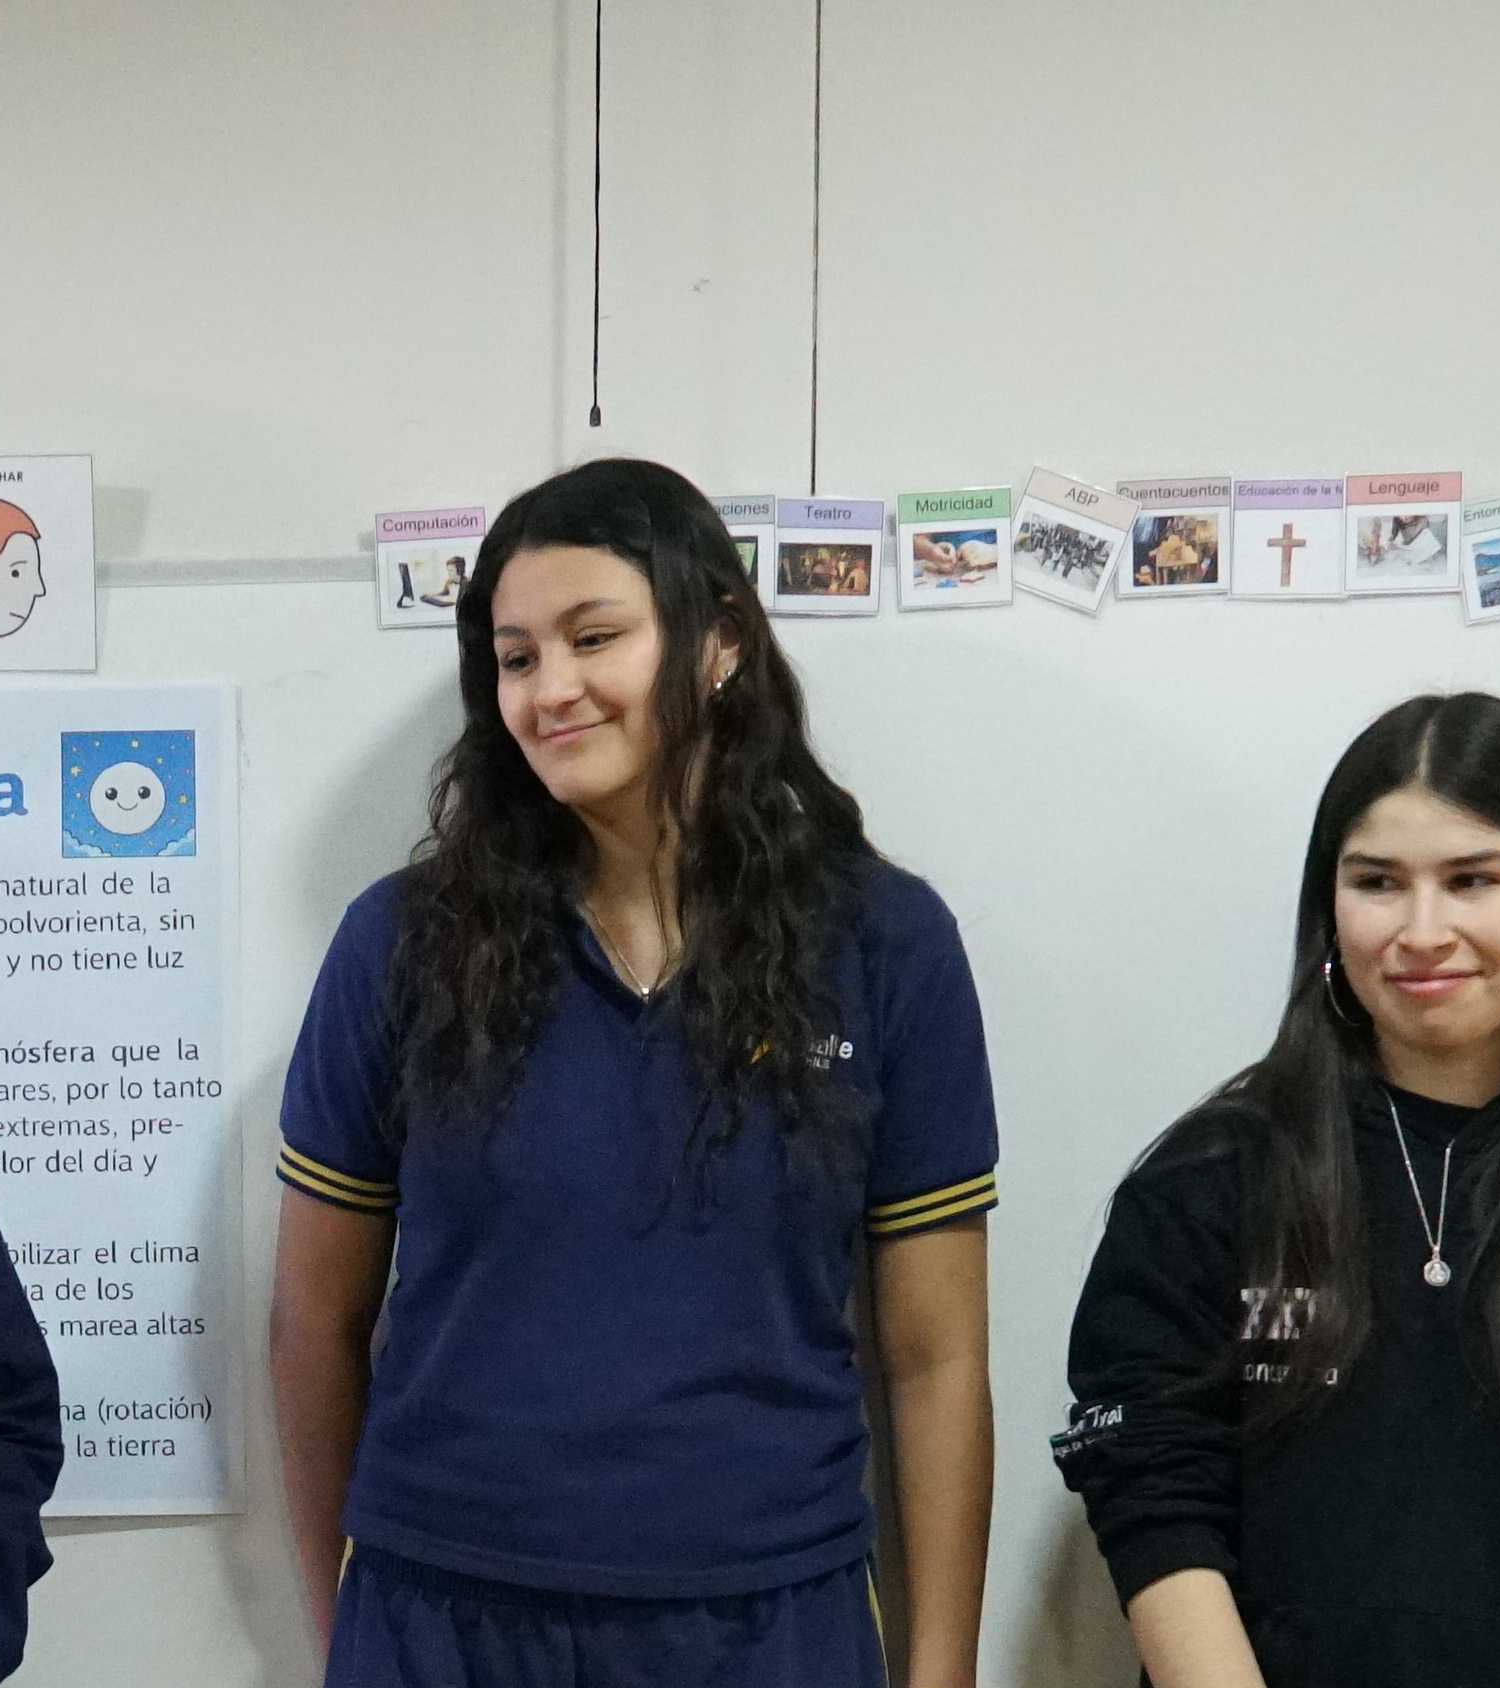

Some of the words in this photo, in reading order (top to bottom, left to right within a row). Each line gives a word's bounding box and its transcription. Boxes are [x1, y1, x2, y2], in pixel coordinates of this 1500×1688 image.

[1064, 486, 1100, 508] ABP
[1118, 485, 1229, 500] Cuentacuentos
[1237, 486, 1299, 497] Educación
[1303, 486, 1318, 497] de
[1368, 480, 1439, 500] Lenguaje
[804, 504, 852, 522] Teatro
[915, 495, 994, 515] Motricidad
[382, 514, 479, 534] Computación
[101, 872, 135, 896] de
[149, 871, 172, 895] la
[159, 907, 195, 931] sin
[7, 954, 22, 978] y
[30, 951, 65, 973] no
[73, 946, 136, 971] tiene
[147, 945, 184, 969] luz
[111, 1042, 161, 1067] que
[177, 1038, 200, 1062] la
[66, 1079, 110, 1106] por
[119, 1076, 143, 1100] lo
[153, 1077, 223, 1099] tanto
[130, 1115, 185, 1141] pre-
[45, 1149, 84, 1174] del
[94, 1148, 134, 1173] día
[143, 1154, 158, 1177] y
[94, 1241, 117, 1264] el
[129, 1241, 200, 1264] clima
[55, 1278, 88, 1302] de
[98, 1277, 135, 1301] los
[59, 1318, 139, 1337] marea
[147, 1312, 206, 1336] altas
[97, 1395, 213, 1427] (rotación)
[75, 1434, 98, 1459] la
[107, 1434, 177, 1458] tierra
